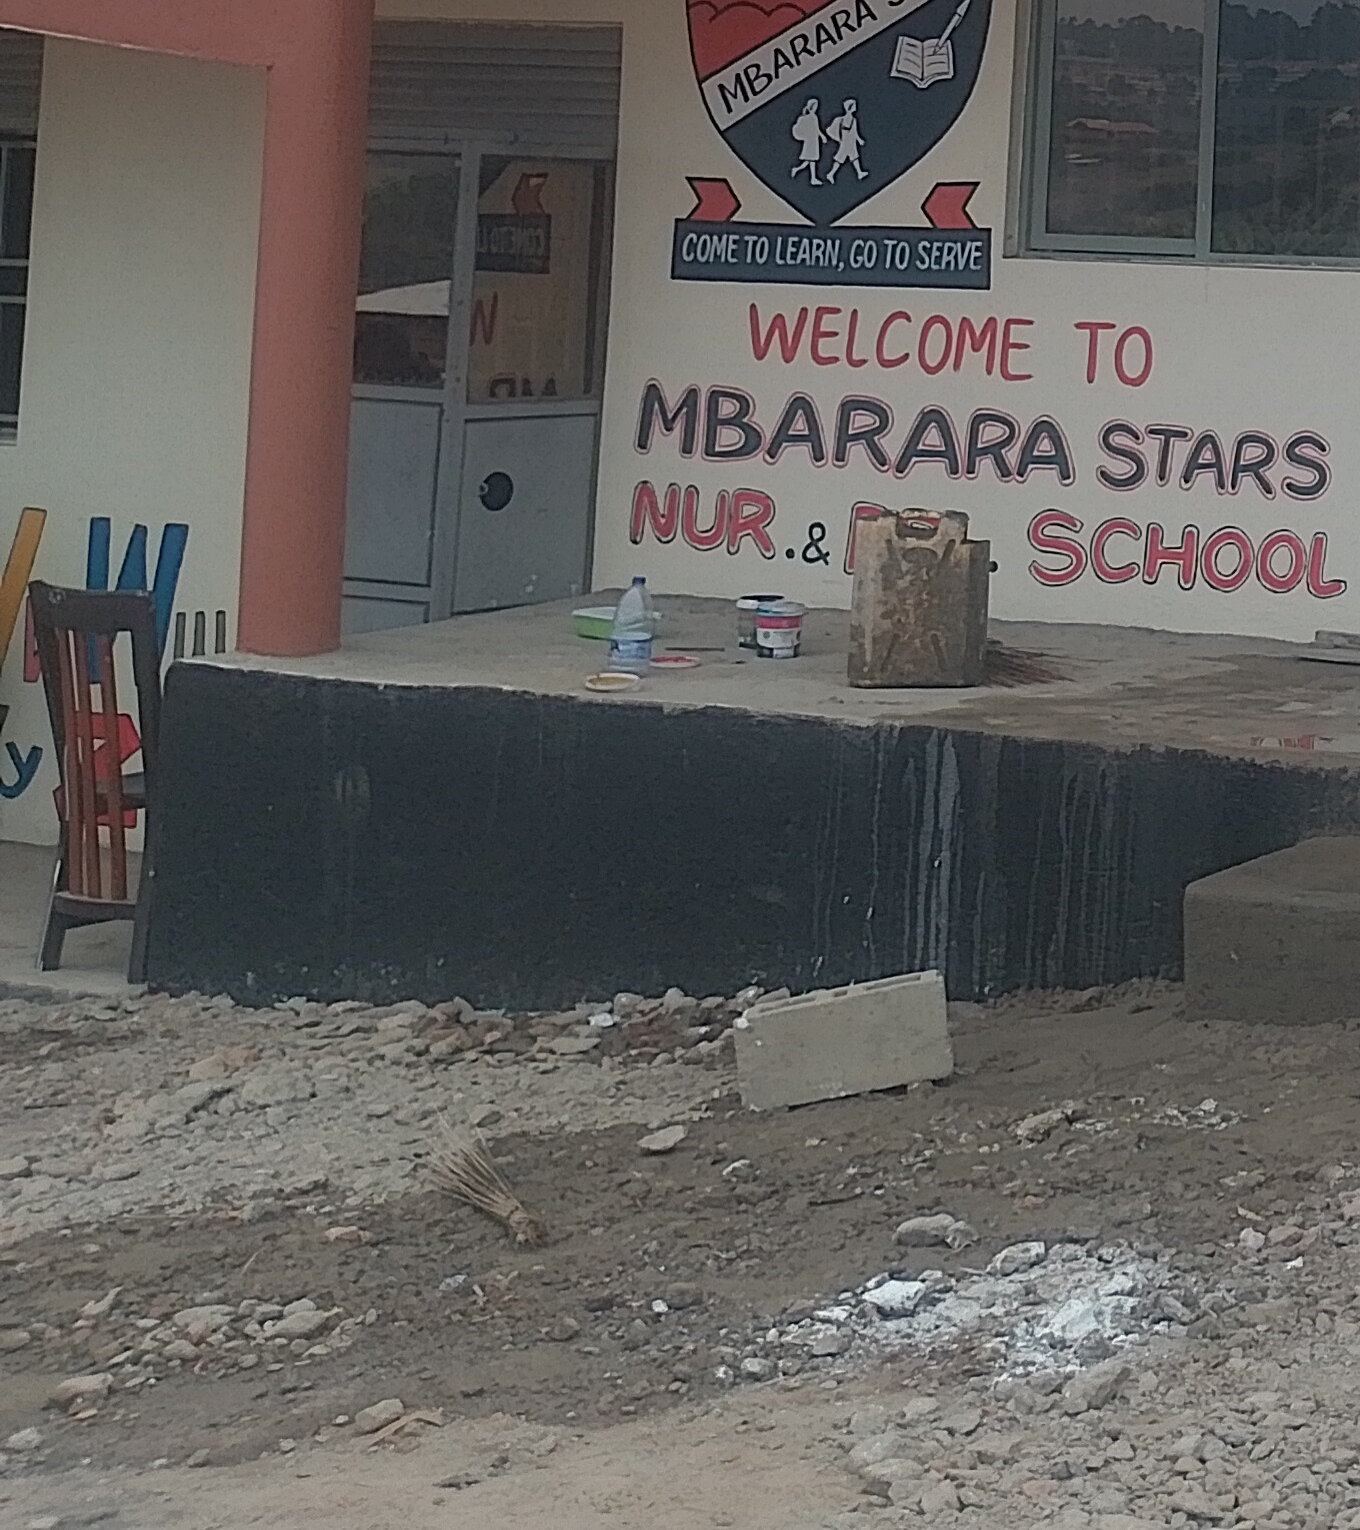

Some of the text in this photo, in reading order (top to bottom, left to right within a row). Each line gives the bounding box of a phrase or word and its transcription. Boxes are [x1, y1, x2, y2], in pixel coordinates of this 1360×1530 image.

[717, 7, 878, 114] MBARARA
[682, 233, 982, 271] COME TO LEARN, GO TO SERVE
[748, 302, 1153, 387] WELCOME TO
[634, 376, 1331, 499] MBARARA STARS
[1027, 508, 1347, 598] SCHOOL
